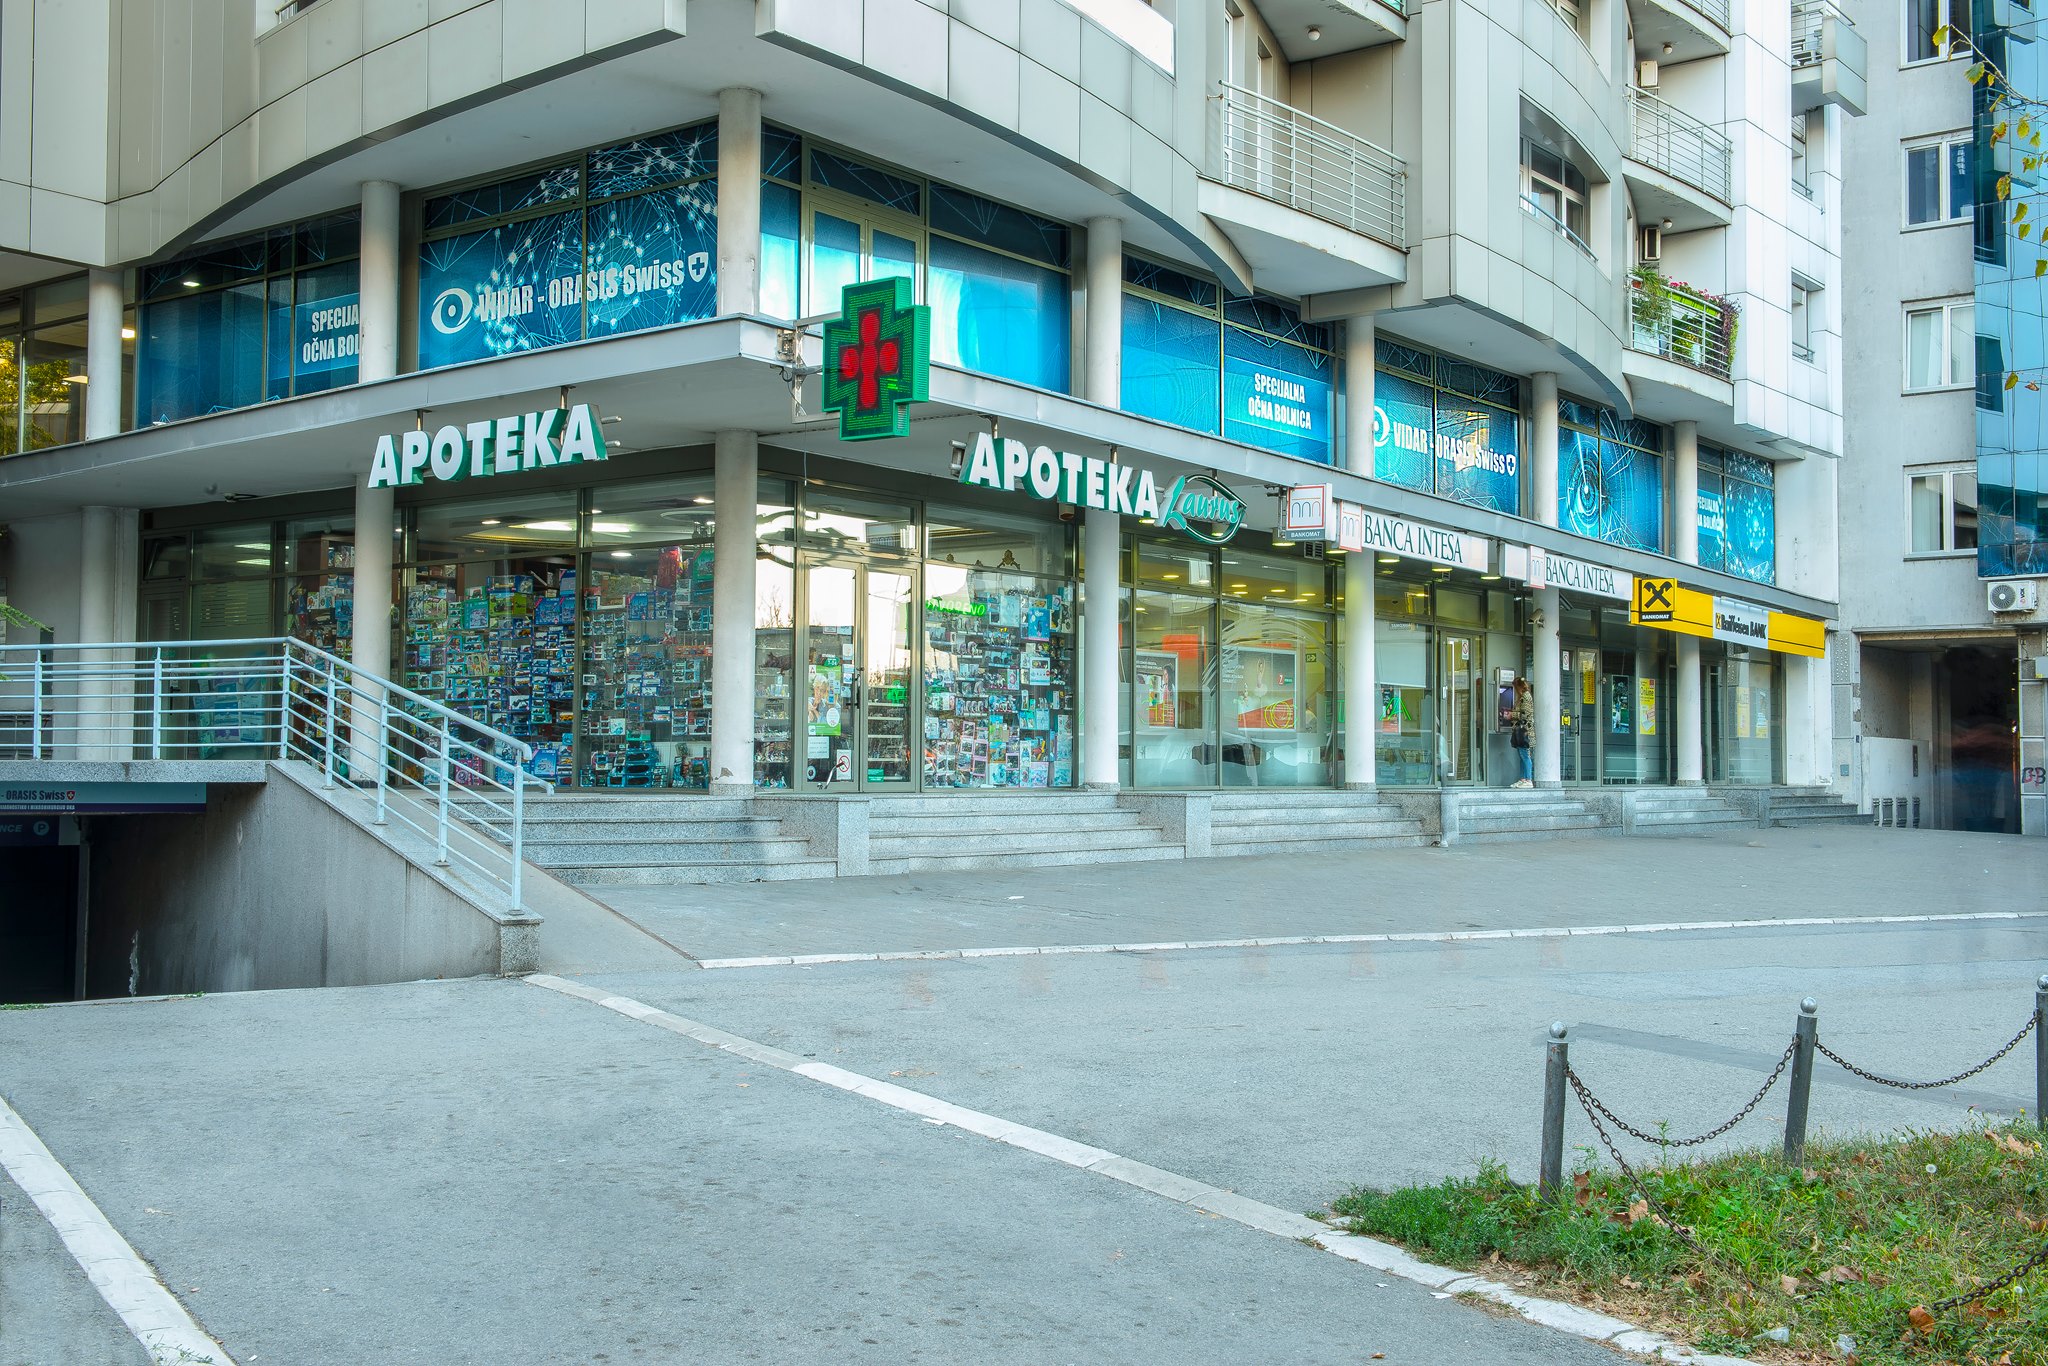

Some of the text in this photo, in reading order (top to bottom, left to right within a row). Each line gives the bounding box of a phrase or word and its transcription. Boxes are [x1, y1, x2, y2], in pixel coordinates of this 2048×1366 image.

[549, 267, 619, 309] ORASIS
[623, 259, 685, 295] Swiss
[303, 337, 335, 364] OČNA
[1254, 373, 1306, 404] SPECIJALNA
[1248, 395, 1312, 430] OČNA BOLNICA
[367, 403, 603, 488] APOTEKA
[1393, 421, 1428, 454] VIDAR
[1475, 445, 1506, 475] Swiss
[964, 432, 1159, 519] APOTEKA
[1159, 475, 1240, 529] Laurus
[1363, 514, 1464, 563] BANCA INTESA
[1545, 556, 1616, 595] BANCA INTESA
[1749, 621, 1767, 639] BANK
[6, 790, 37, 800] ORASIS
[39, 790, 65, 800] Swiss
